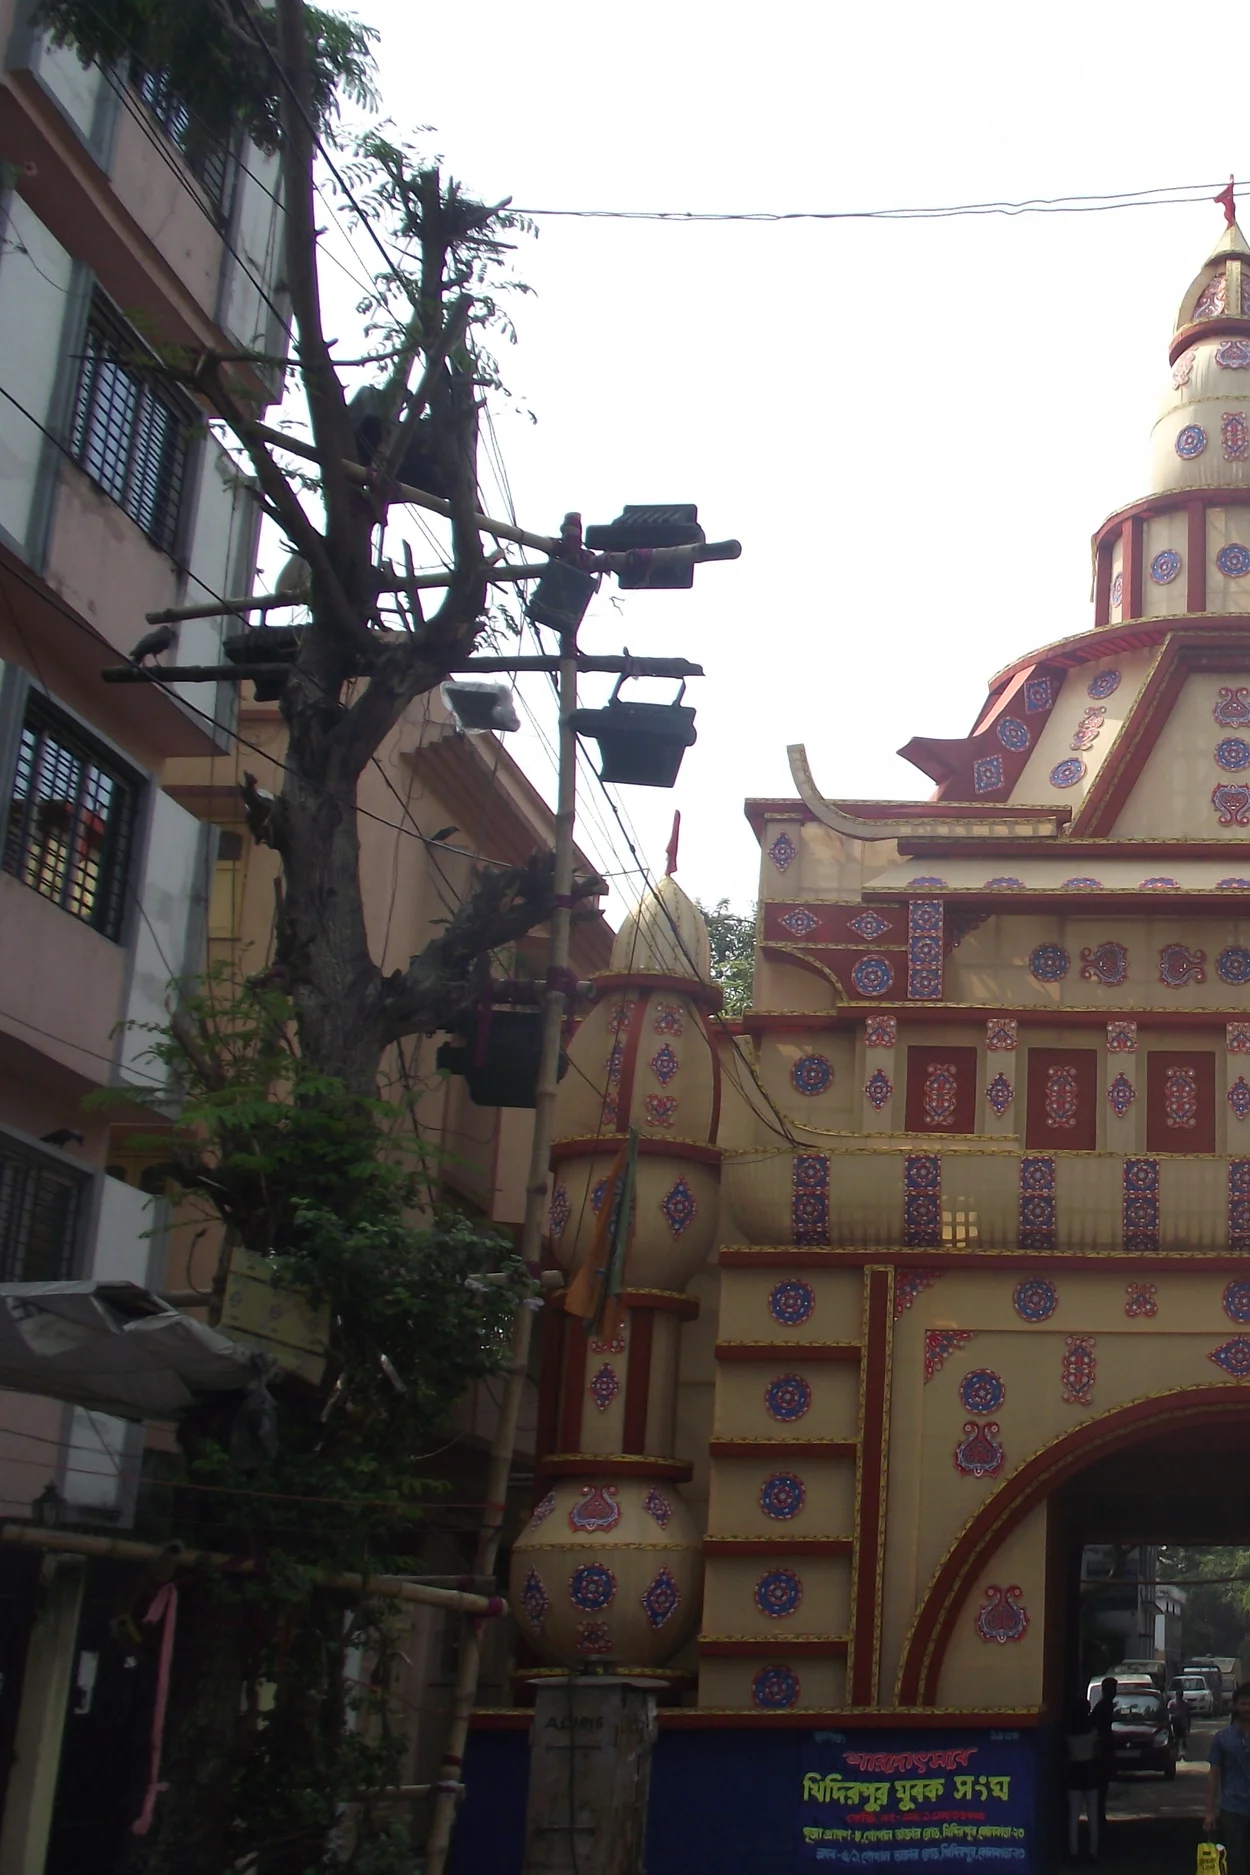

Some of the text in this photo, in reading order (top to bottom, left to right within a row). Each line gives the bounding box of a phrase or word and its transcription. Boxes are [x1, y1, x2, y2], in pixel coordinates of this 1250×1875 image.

[803, 1772, 1011, 1812] খিদিরপুর যুবক সংঘ
